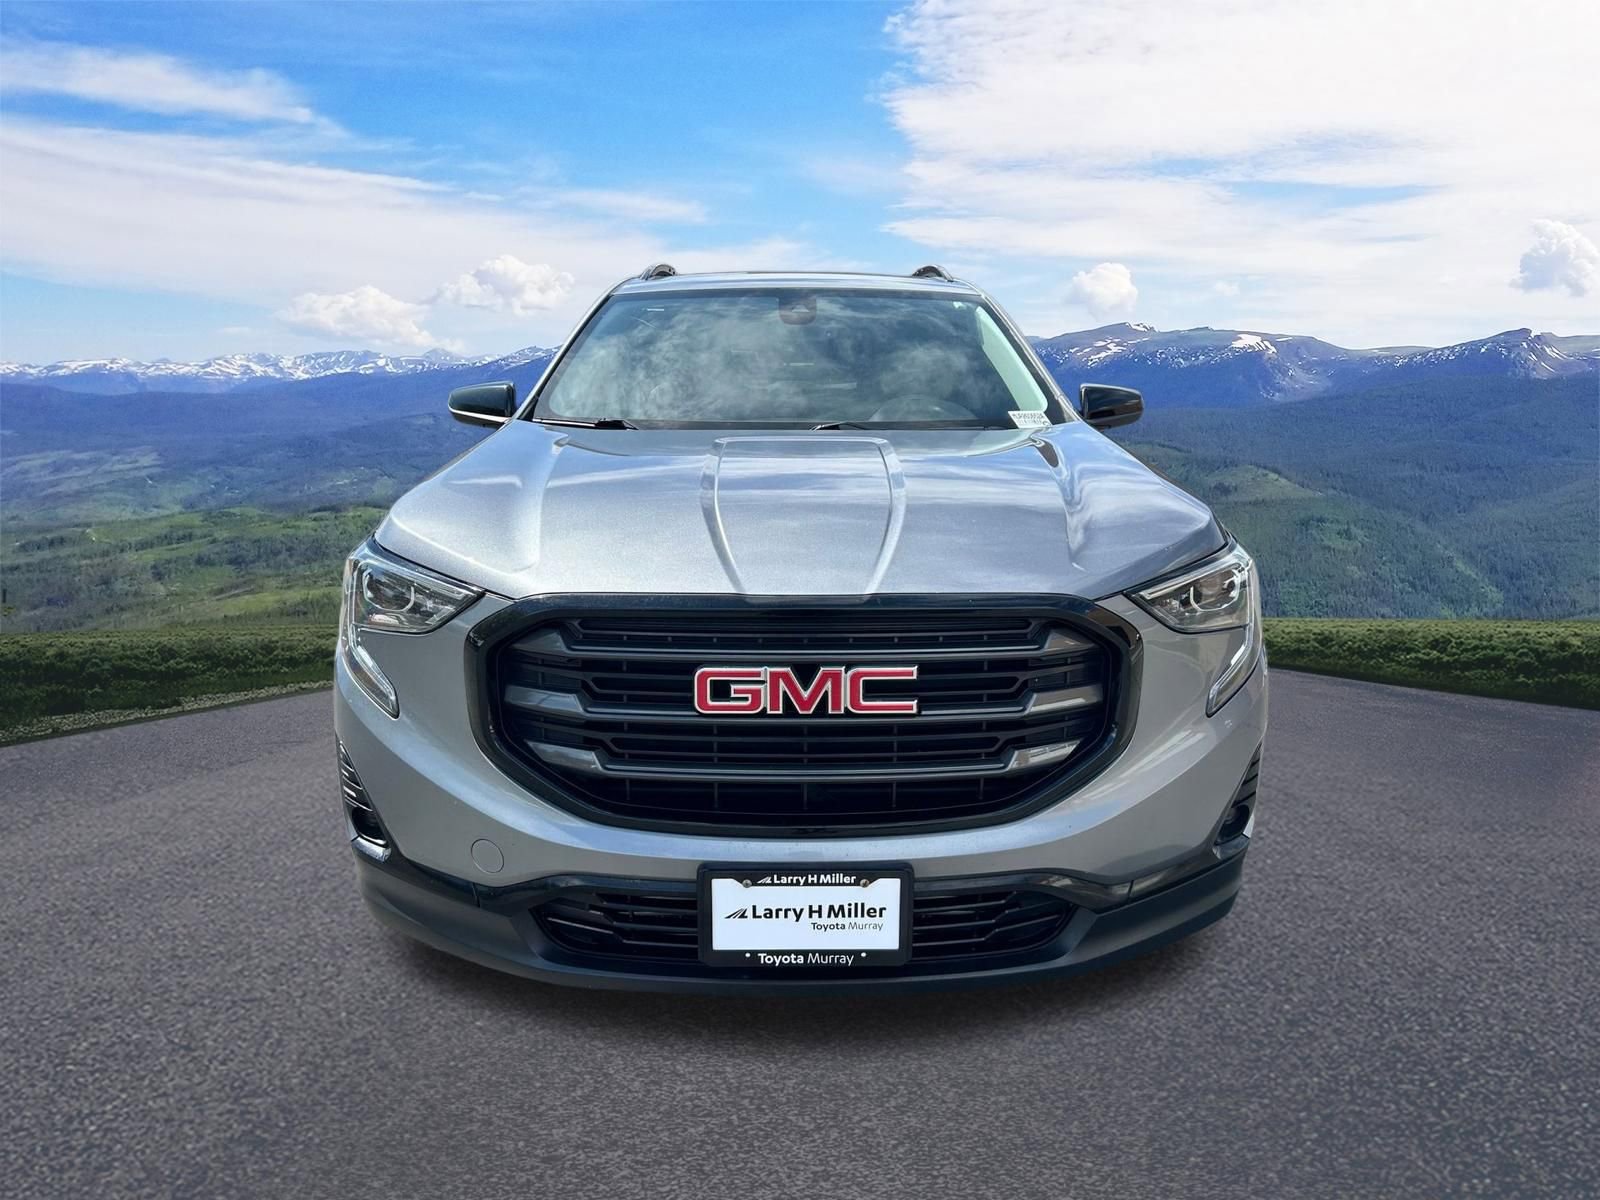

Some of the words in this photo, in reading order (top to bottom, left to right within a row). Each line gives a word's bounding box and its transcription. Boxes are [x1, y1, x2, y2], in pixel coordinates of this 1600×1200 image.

[694, 666, 918, 714] GMC
[773, 874, 805, 886] Larry
[808, 874, 817, 884] H
[820, 873, 856, 884] Miller
[752, 904, 804, 922] Larry
[808, 905, 823, 919] H
[827, 902, 886, 919] Miller
[811, 922, 845, 931] Toyota
[848, 922, 883, 931] Murray
[758, 952, 804, 966] Toyota
[807, 952, 854, 966] Murray
